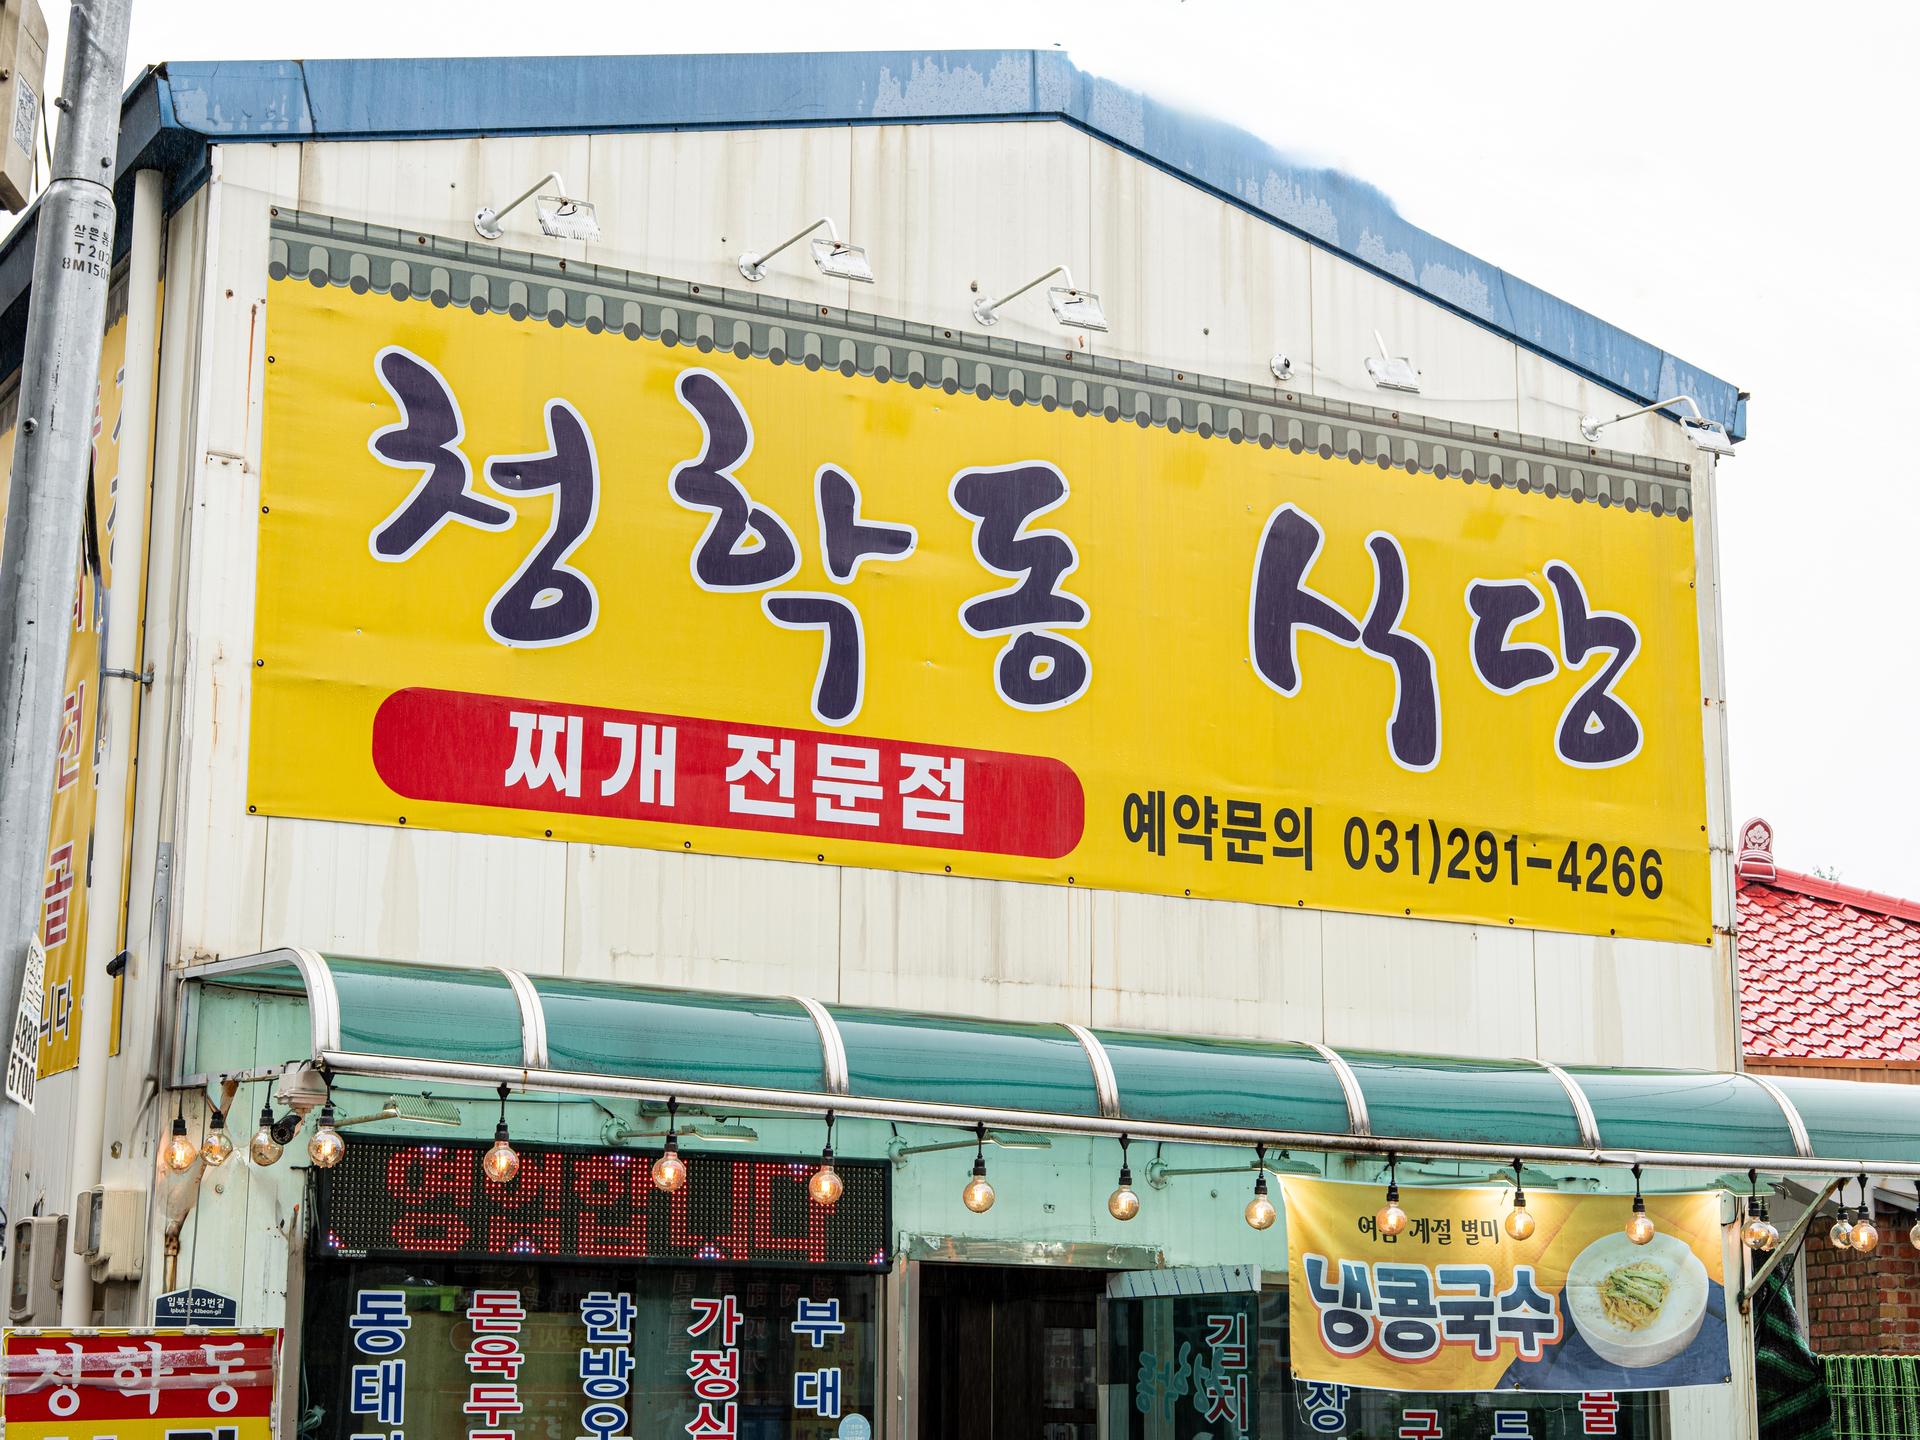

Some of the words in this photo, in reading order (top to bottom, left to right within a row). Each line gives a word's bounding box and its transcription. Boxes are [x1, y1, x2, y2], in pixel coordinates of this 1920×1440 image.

[368, 345, 1092, 727] 청학동
[1248, 502, 1643, 772] 식당
[504, 711, 677, 807] 찌개
[725, 734, 965, 835] 전문점
[1122, 789, 1314, 871] 예약문의
[1343, 815, 1664, 900] 031)291-4266
[1409, 1217, 1451, 1245] 계절
[1461, 1218, 1500, 1245] 별미
[349, 1290, 412, 1440] 동태
[463, 1290, 526, 1440] 돈육두
[791, 1297, 845, 1440] 부대
[1303, 1253, 1561, 1361] 냉콩국수
[1205, 1312, 1249, 1440] 김치
